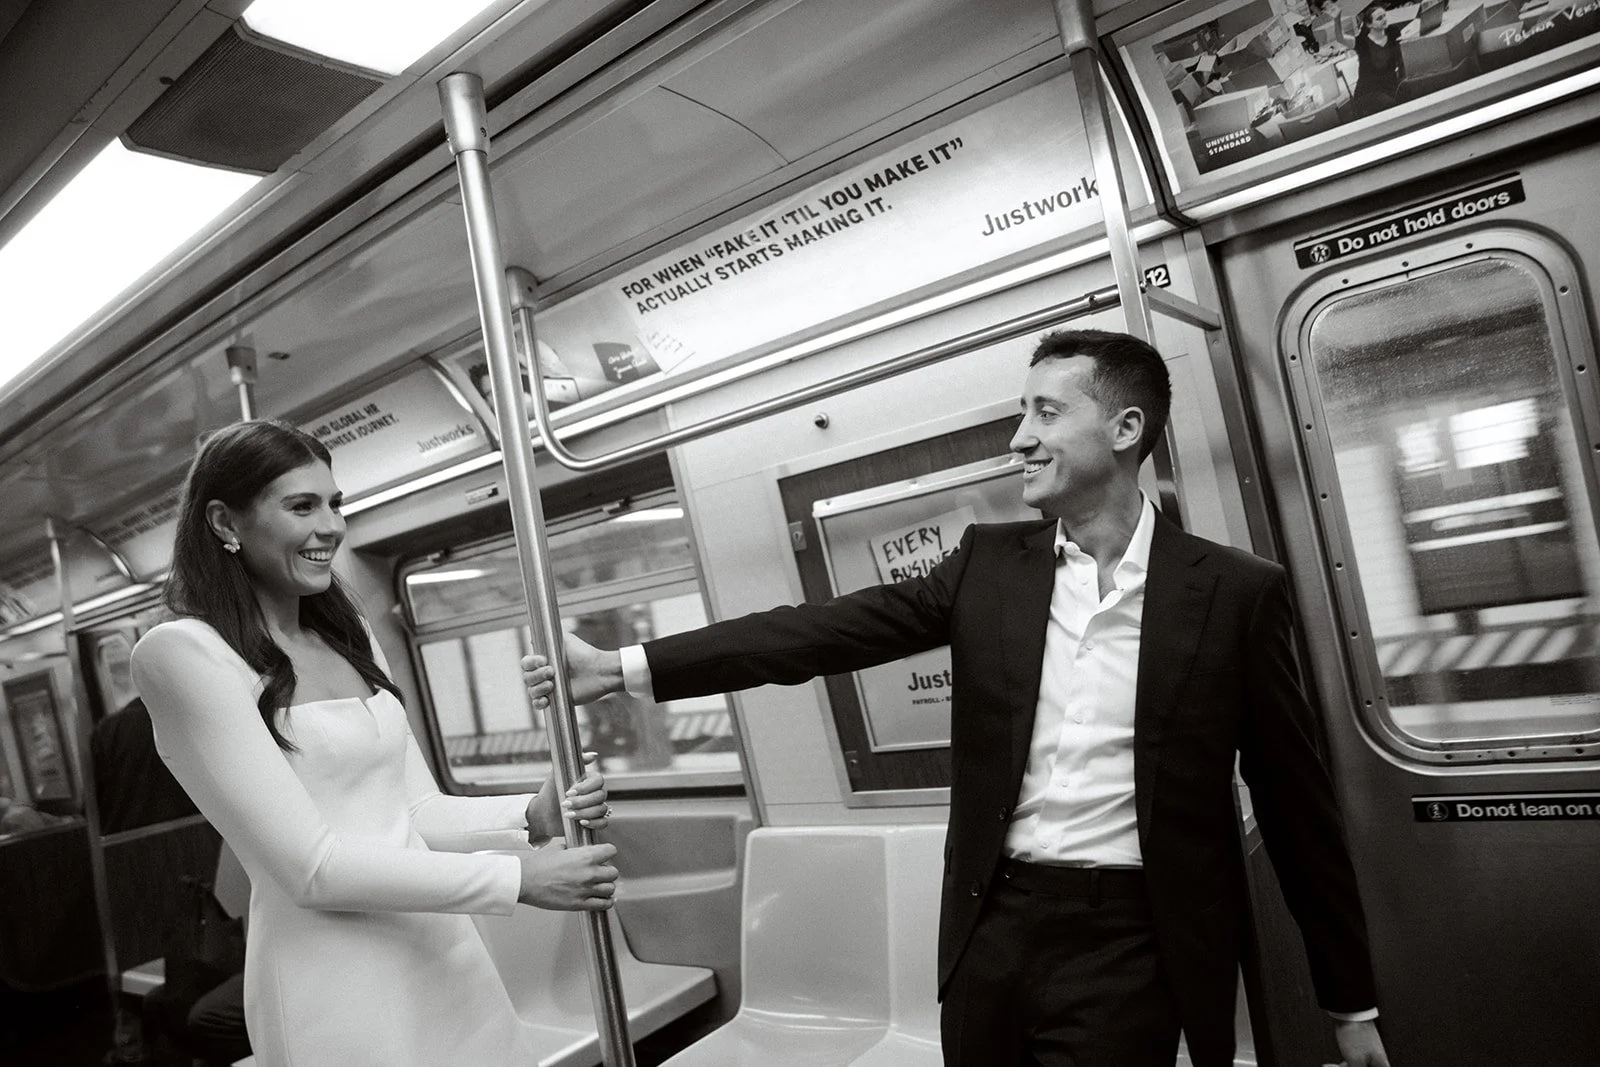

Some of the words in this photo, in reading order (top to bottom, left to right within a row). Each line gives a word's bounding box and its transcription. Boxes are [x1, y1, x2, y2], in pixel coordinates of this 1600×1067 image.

[1205, 128, 1250, 148] UNIVERSAL
[1208, 136, 1252, 156] STANDARD
[621, 274, 654, 299] FOR
[653, 254, 706, 285] WHEN
[705, 229, 761, 261] “FAKE
[759, 220, 780, 239] IT
[820, 184, 863, 213] YOU
[862, 154, 929, 193] MAKE
[929, 137, 965, 165] IT”
[982, 177, 1099, 237] Justwork
[1337, 235, 1364, 254] Do
[1368, 223, 1400, 245] not
[1404, 208, 1446, 234] hold
[1451, 190, 1511, 219] doors
[636, 272, 714, 315] ACTUALLY
[718, 244, 784, 280] STARTS
[785, 209, 863, 251] MAKING
[866, 196, 892, 220] IT.
[329, 410, 366, 431] GLOBAL
[363, 403, 381, 416] HR
[355, 413, 400, 438] JOURNEY.
[418, 423, 474, 453] Justworks
[883, 526, 942, 563] EVERY
[890, 546, 960, 584] BUSIN
[908, 669, 952, 691] Just
[912, 697, 941, 705] PAYROLL
[1456, 803, 1484, 817] Do
[1486, 803, 1518, 817] not
[1520, 803, 1563, 817] lean
[1565, 803, 1593, 817] on
